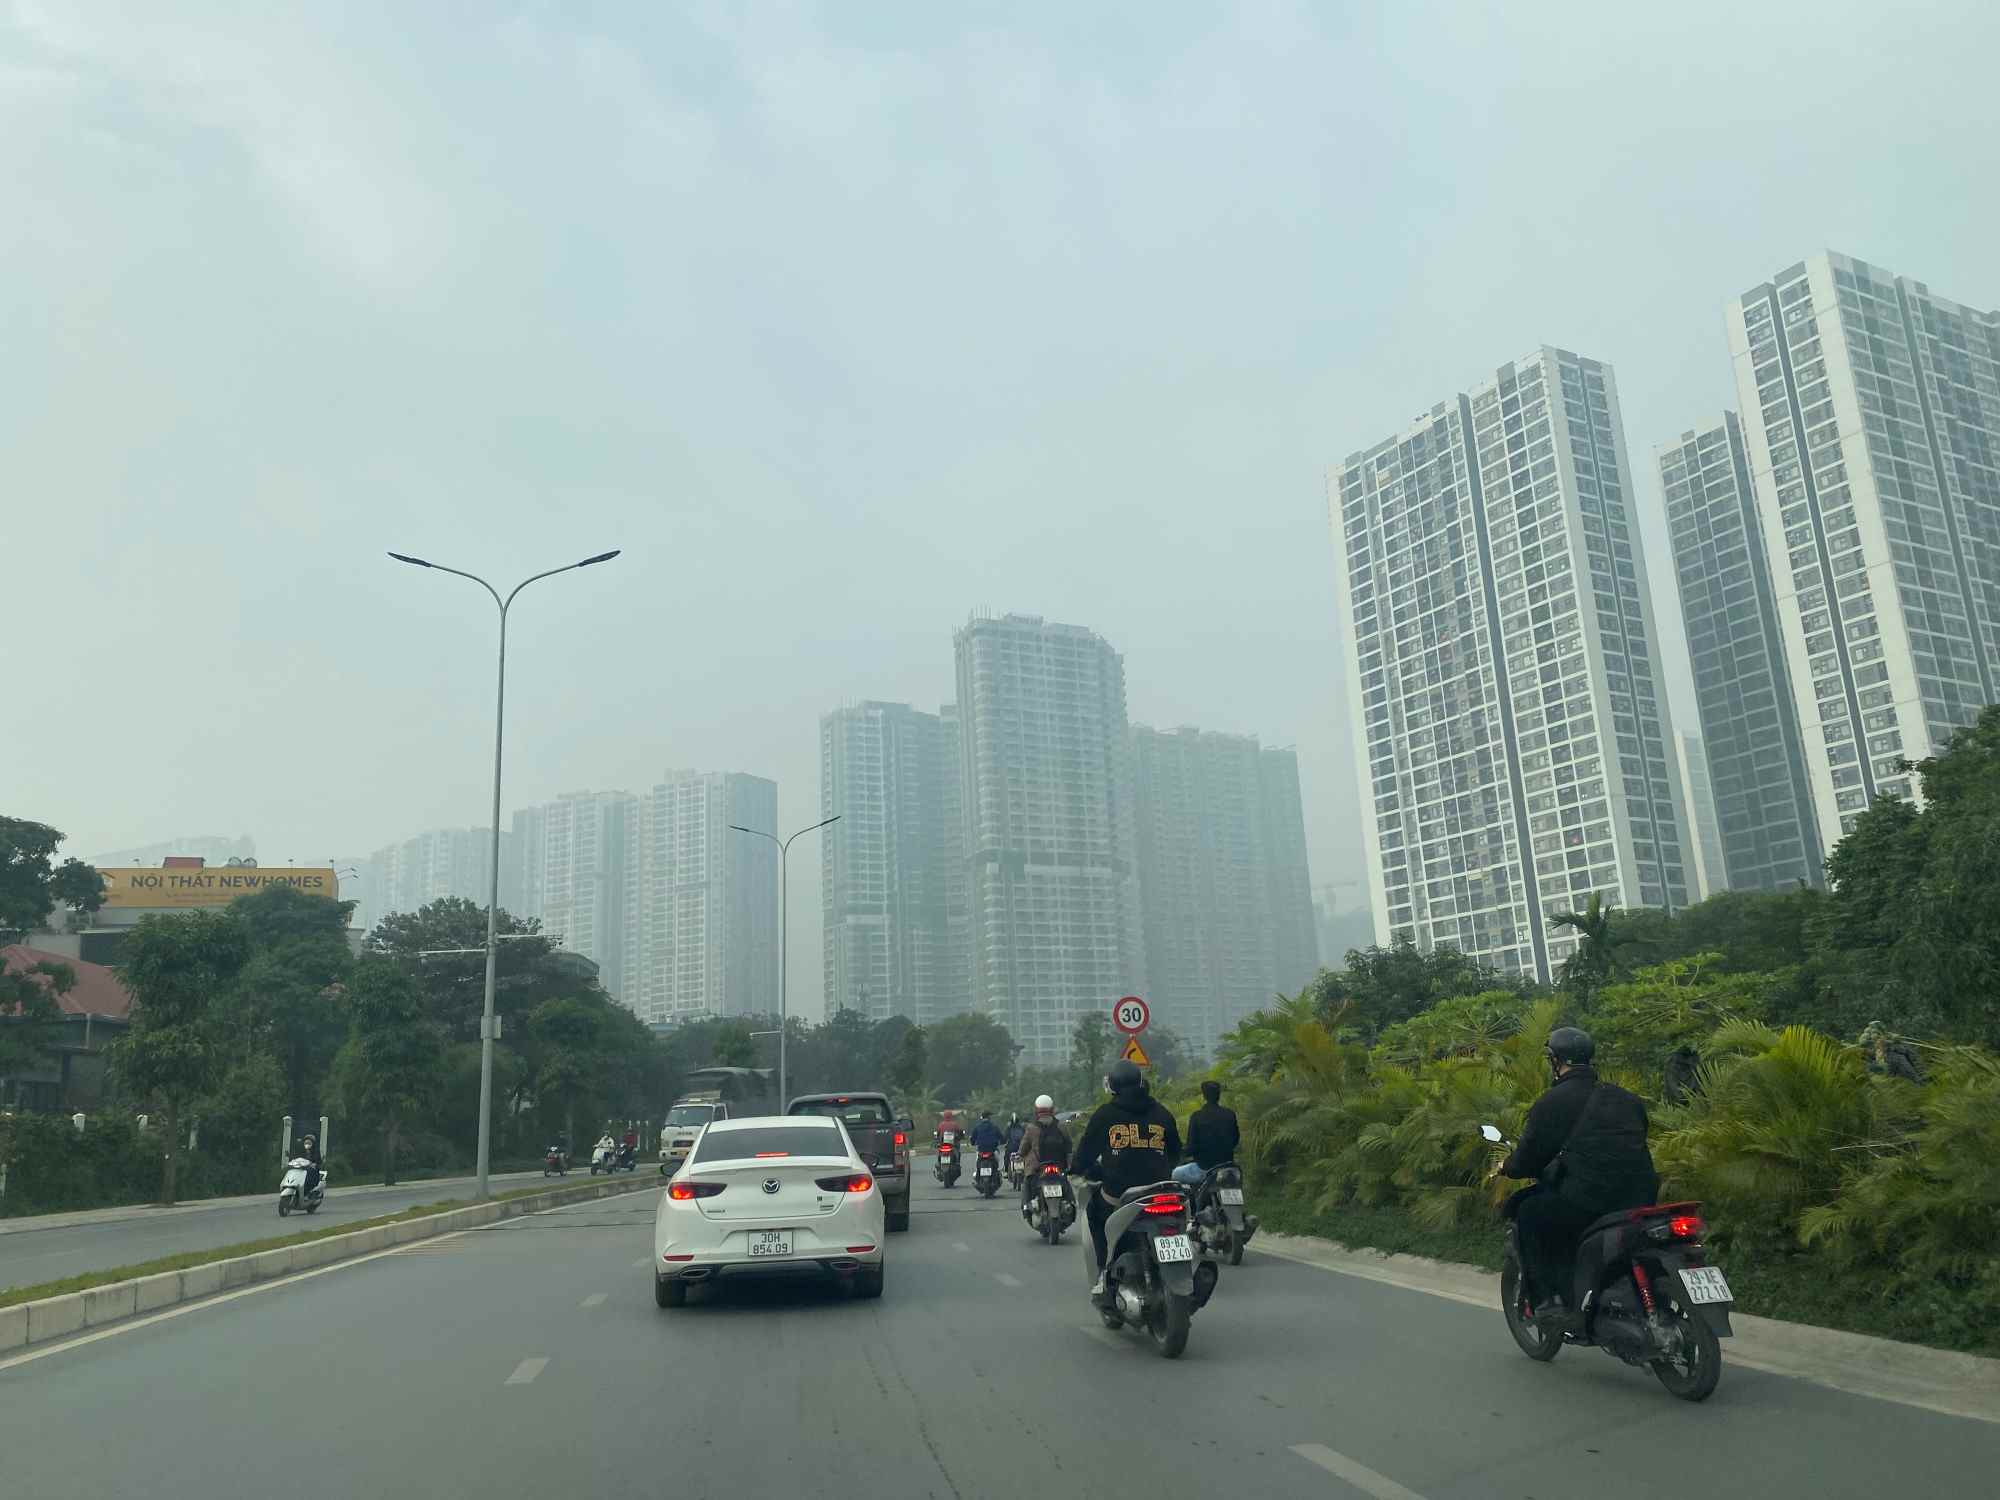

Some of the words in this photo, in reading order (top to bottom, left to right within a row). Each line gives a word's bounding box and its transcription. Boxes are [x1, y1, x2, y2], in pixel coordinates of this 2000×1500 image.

[220, 875, 323, 888] NEWHOMES
[1122, 1007, 1142, 1023] 30
[761, 1232, 781, 1243] 30H
